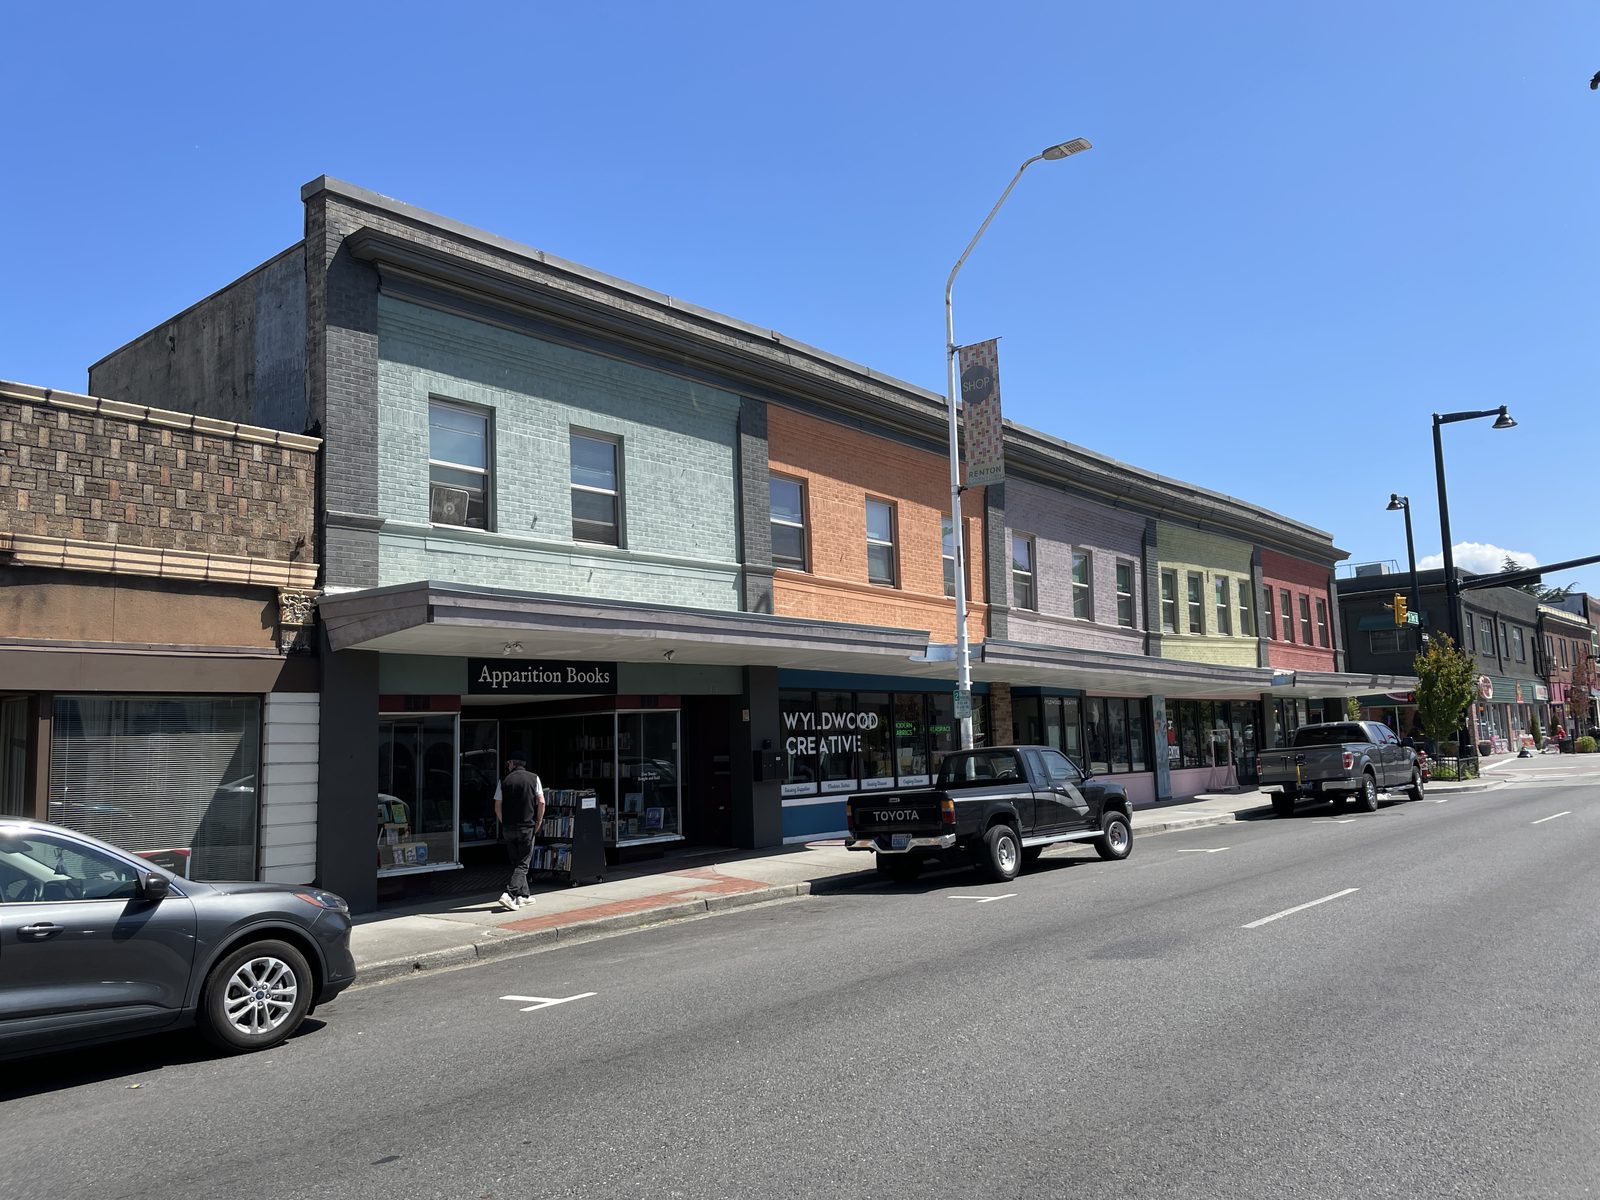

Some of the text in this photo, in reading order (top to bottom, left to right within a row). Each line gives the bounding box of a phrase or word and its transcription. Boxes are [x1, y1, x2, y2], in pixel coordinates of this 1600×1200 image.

[962, 376, 990, 393] SHOP
[968, 465, 1002, 479] RENTON
[478, 664, 610, 688] Apparition Books
[783, 711, 879, 731] WYLDWOOD
[786, 735, 862, 756] CREATIVE
[873, 810, 920, 821] TOYOTA
